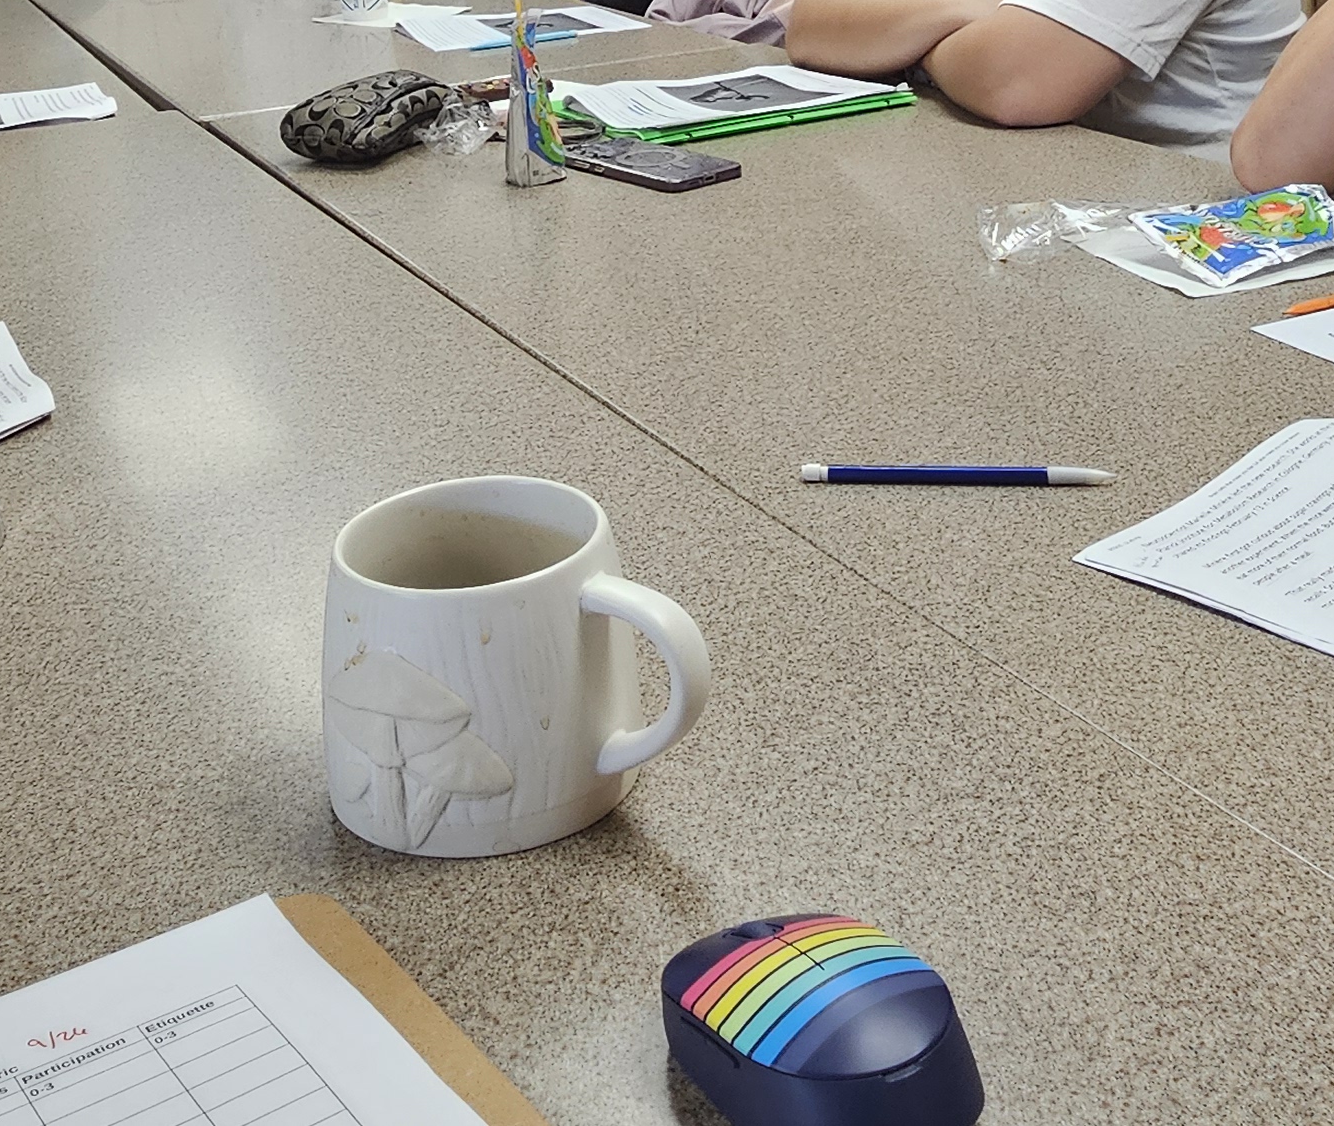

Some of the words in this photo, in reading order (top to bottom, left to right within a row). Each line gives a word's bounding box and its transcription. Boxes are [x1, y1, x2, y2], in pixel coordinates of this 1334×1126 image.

[144, 1000, 215, 1034] Etiquette
[154, 1029, 177, 1045] 0-3
[21, 1036, 126, 1085] Participation
[29, 1082, 55, 1098] 0-3
